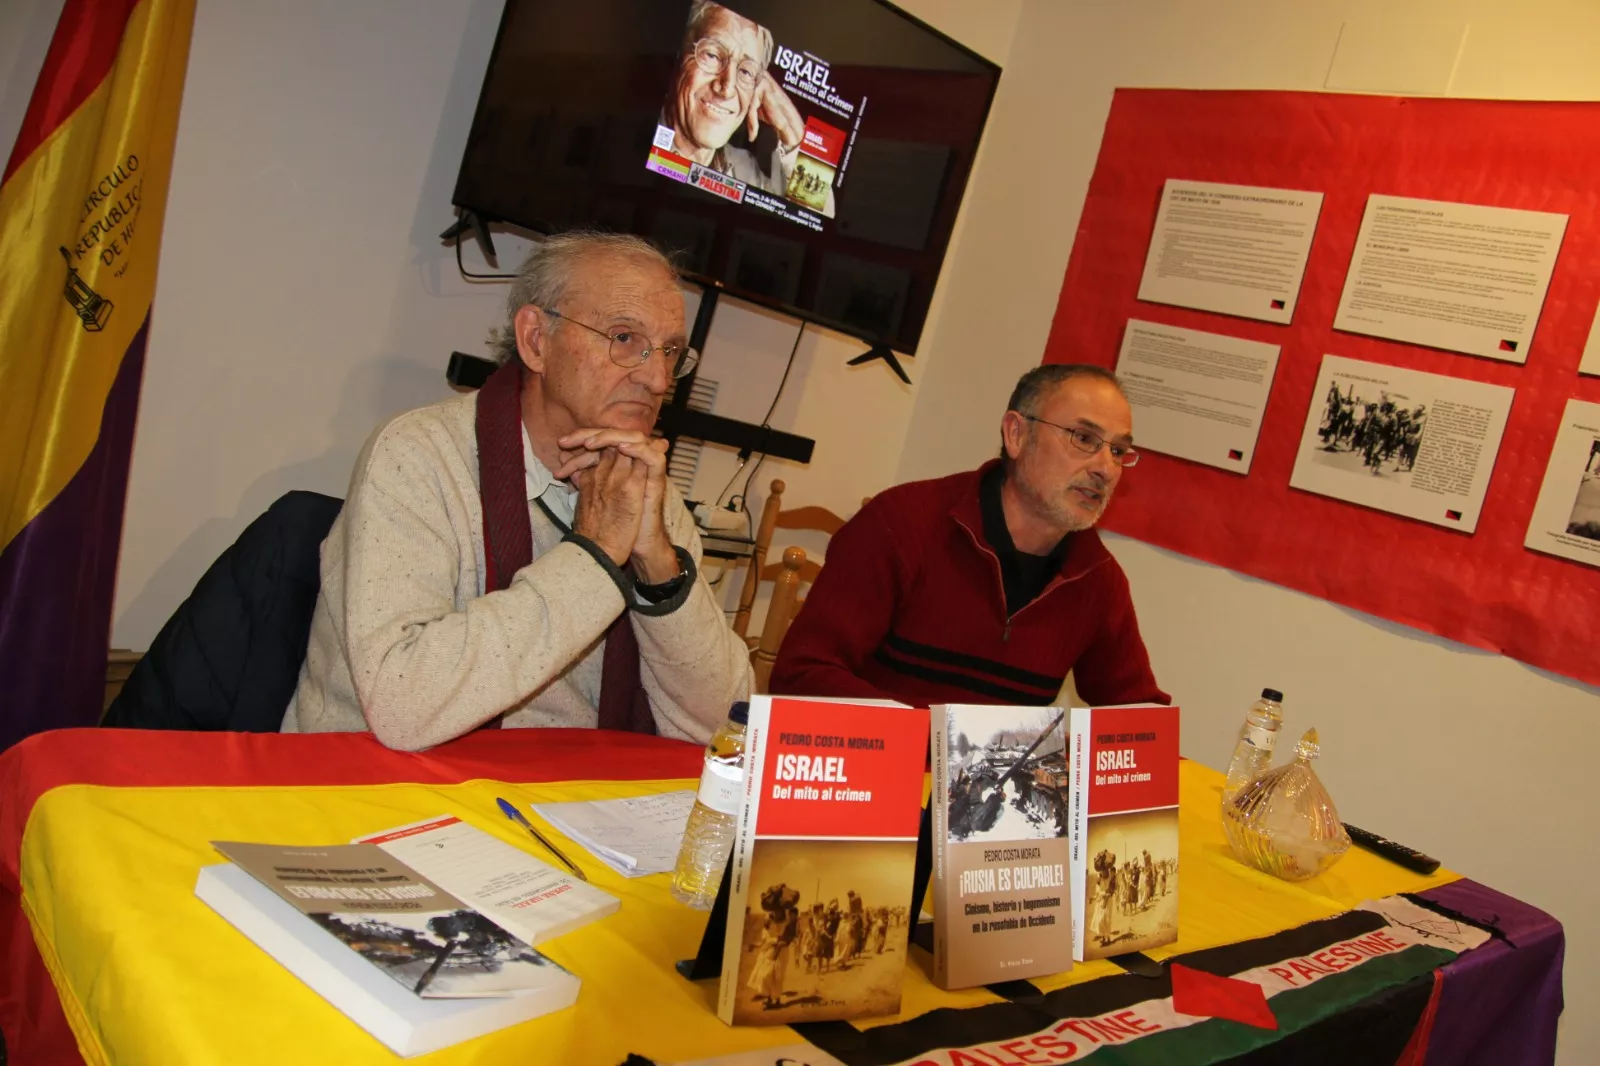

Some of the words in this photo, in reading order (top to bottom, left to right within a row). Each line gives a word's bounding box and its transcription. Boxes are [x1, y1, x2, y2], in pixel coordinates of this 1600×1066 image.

[774, 45, 836, 93] ISRAEL.
[784, 70, 799, 86] Del
[799, 80, 817, 95] mito
[818, 89, 827, 99] al
[827, 94, 854, 113] crimen
[657, 165, 688, 183] CRMAHU
[703, 169, 723, 182] HUESCA
[81, 154, 139, 223] IRCULO
[698, 175, 741, 201] PALESTINA
[100, 240, 121, 266] DE
[779, 732, 812, 748] PEDRO
[813, 734, 845, 749] COSTA
[848, 737, 885, 751] MORATA
[1096, 734, 1115, 744] PEDRO
[1116, 733, 1134, 743] COSTA
[1134, 732, 1156, 742] MORATA
[775, 753, 848, 783] ISRAEL
[1096, 749, 1137, 771] ISRAEL
[1095, 774, 1106, 785] Del
[1107, 773, 1121, 785] mito
[1122, 772, 1129, 783] al
[1130, 772, 1151, 782] crimen
[772, 784, 791, 800] Del
[794, 786, 819, 801] mito
[821, 786, 832, 801] al
[835, 788, 872, 802] crimen
[984, 848, 1003, 863] PEDRO
[1003, 848, 1021, 862] COSTA
[1020, 847, 1041, 860] MORATA
[959, 868, 996, 898] ¡RUSIA
[998, 867, 1012, 892] ES
[1013, 864, 1064, 891] CULPABLE!
[1018, 901, 1023, 912] y
[972, 923, 981, 934] en
[981, 920, 988, 932] la
[1020, 917, 1028, 929] de
[1028, 914, 1056, 928] Occidente
[1268, 931, 1408, 986] PALESTINE
[907, 1010, 1162, 1066] ALESTINE
